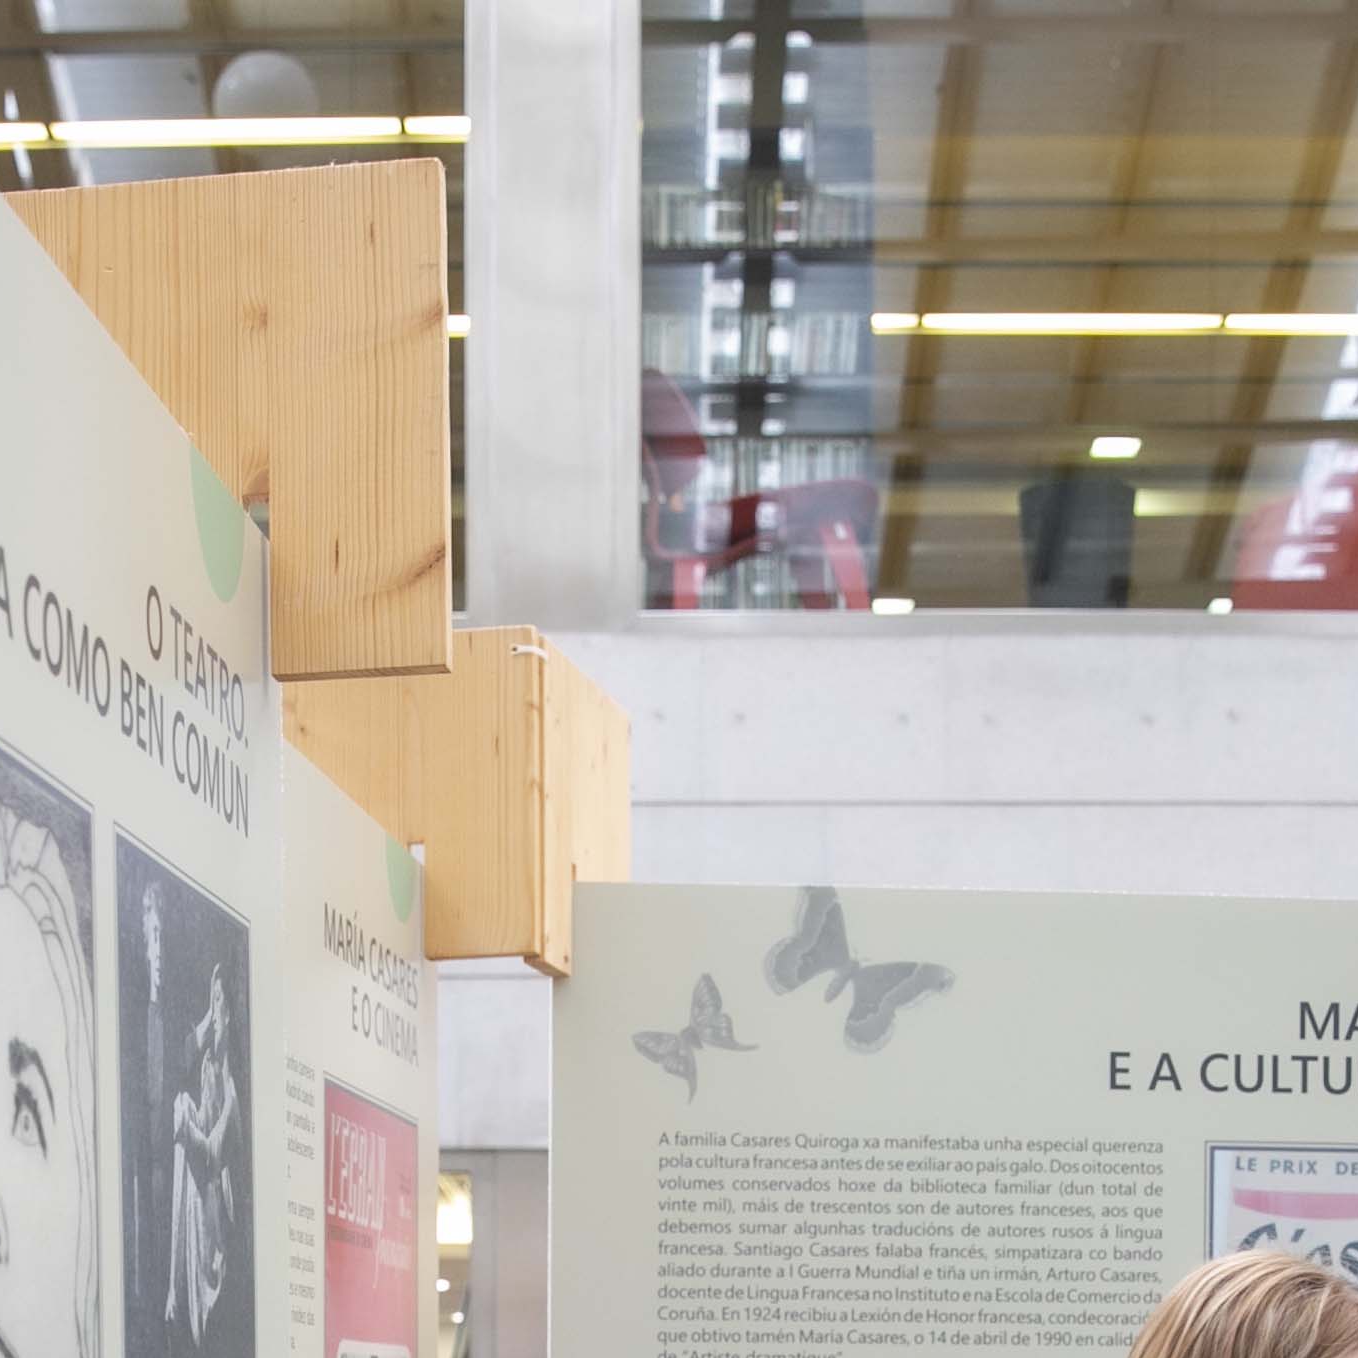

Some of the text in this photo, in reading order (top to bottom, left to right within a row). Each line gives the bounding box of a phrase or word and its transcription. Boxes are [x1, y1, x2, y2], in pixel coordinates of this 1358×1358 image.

[145, 584, 163, 662] O
[23, 573, 111, 717] COMO
[120, 657, 164, 768] BEN
[172, 710, 248, 838] COMÚN
[1109, 1051, 1131, 1090] E
[1147, 1052, 1182, 1091] A
[658, 1130, 1163, 1157] A familia Casares Quiroga xa manifestaba unha especial querenza
[1234, 1155, 1257, 1172] LE
[1269, 1159, 1317, 1176] PRIX
[657, 1175, 1163, 1198] volumes conservados hoxe da biblioteca familiar (dun total de
